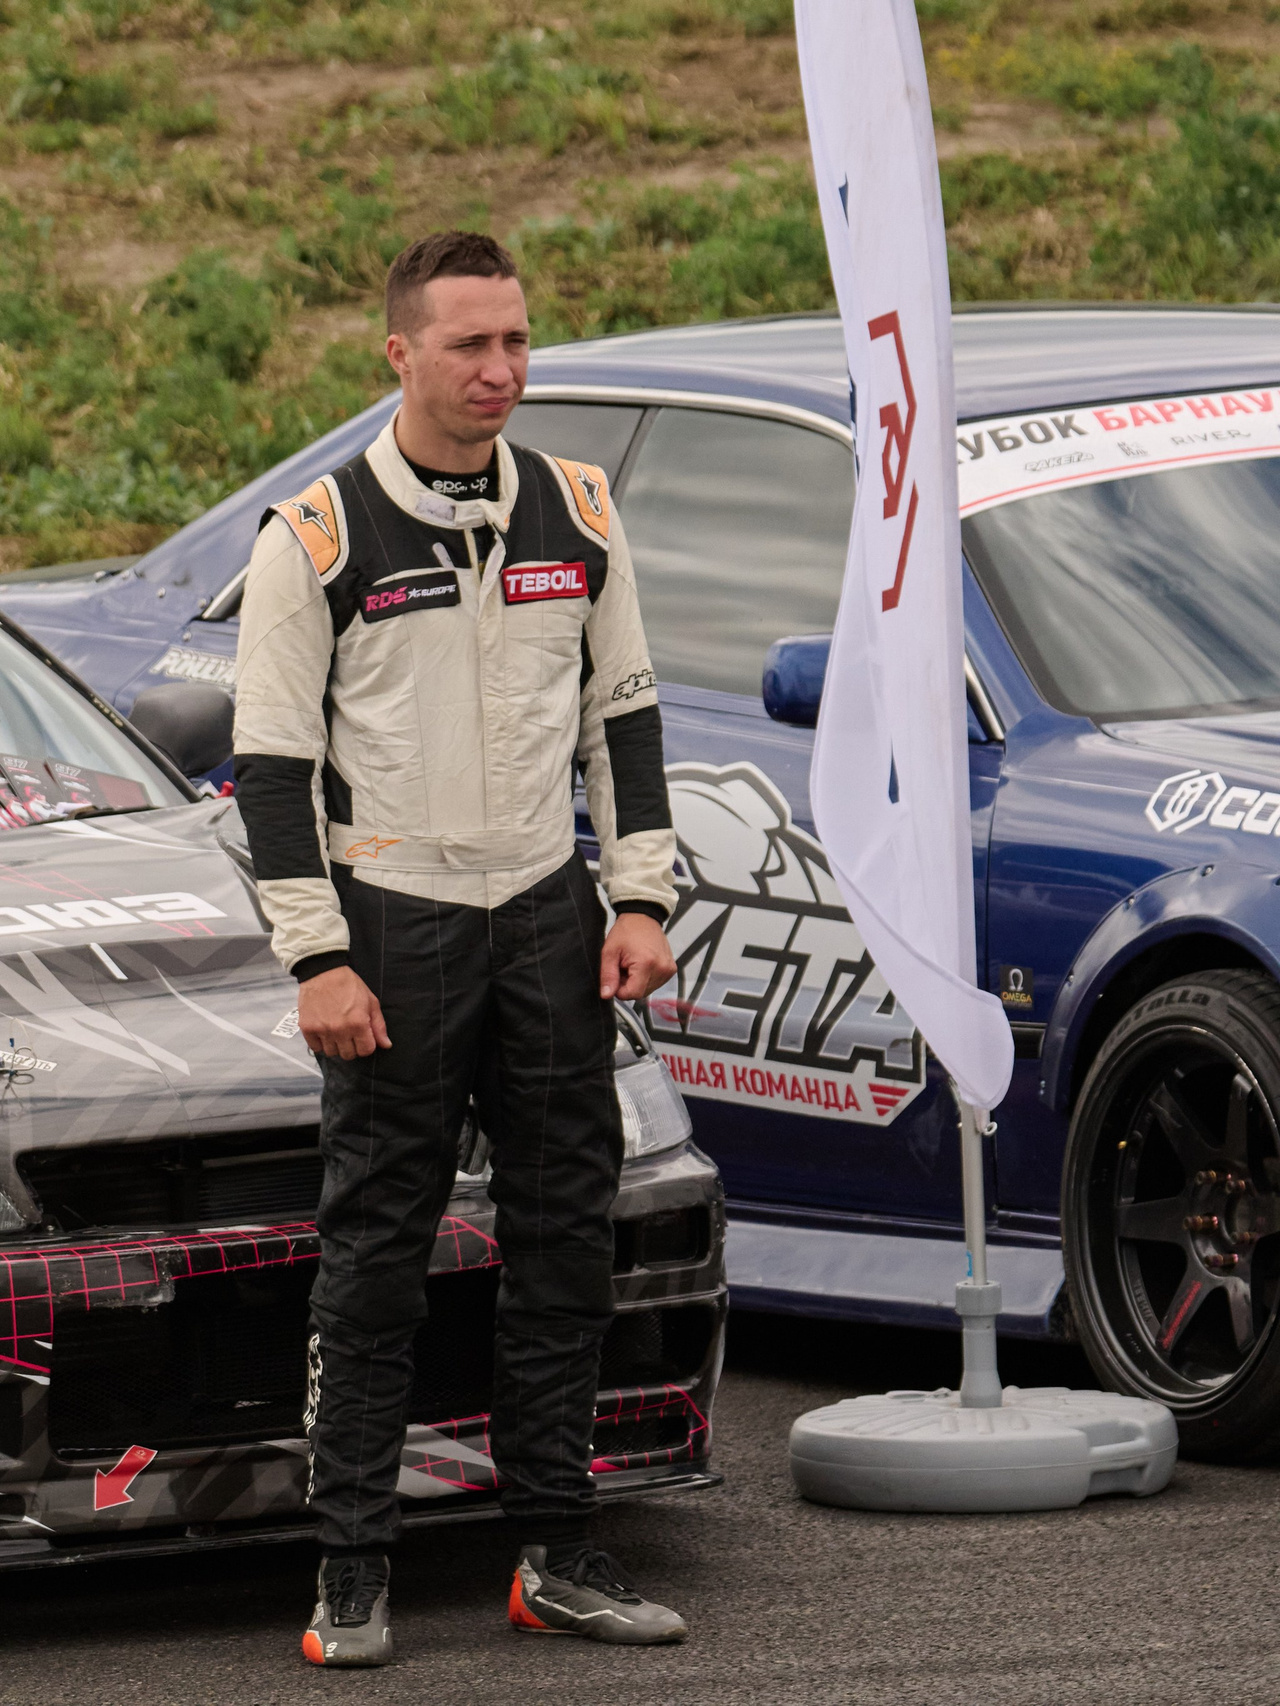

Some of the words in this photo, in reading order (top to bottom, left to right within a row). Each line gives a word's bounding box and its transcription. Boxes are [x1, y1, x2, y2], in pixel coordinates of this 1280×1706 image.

[957, 413, 1089, 465] УБОК
[1091, 388, 1280, 433] БАРНАУ
[1171, 428, 1252, 447] RIVER
[365, 586, 408, 612] RDS
[506, 570, 582, 595] TEBOIL
[1209, 786, 1280, 837] СО
[649, 897, 917, 1072] КЕТА
[1001, 991, 1033, 1003] OMEGA
[732, 1065, 862, 1112] КОМАНДА
